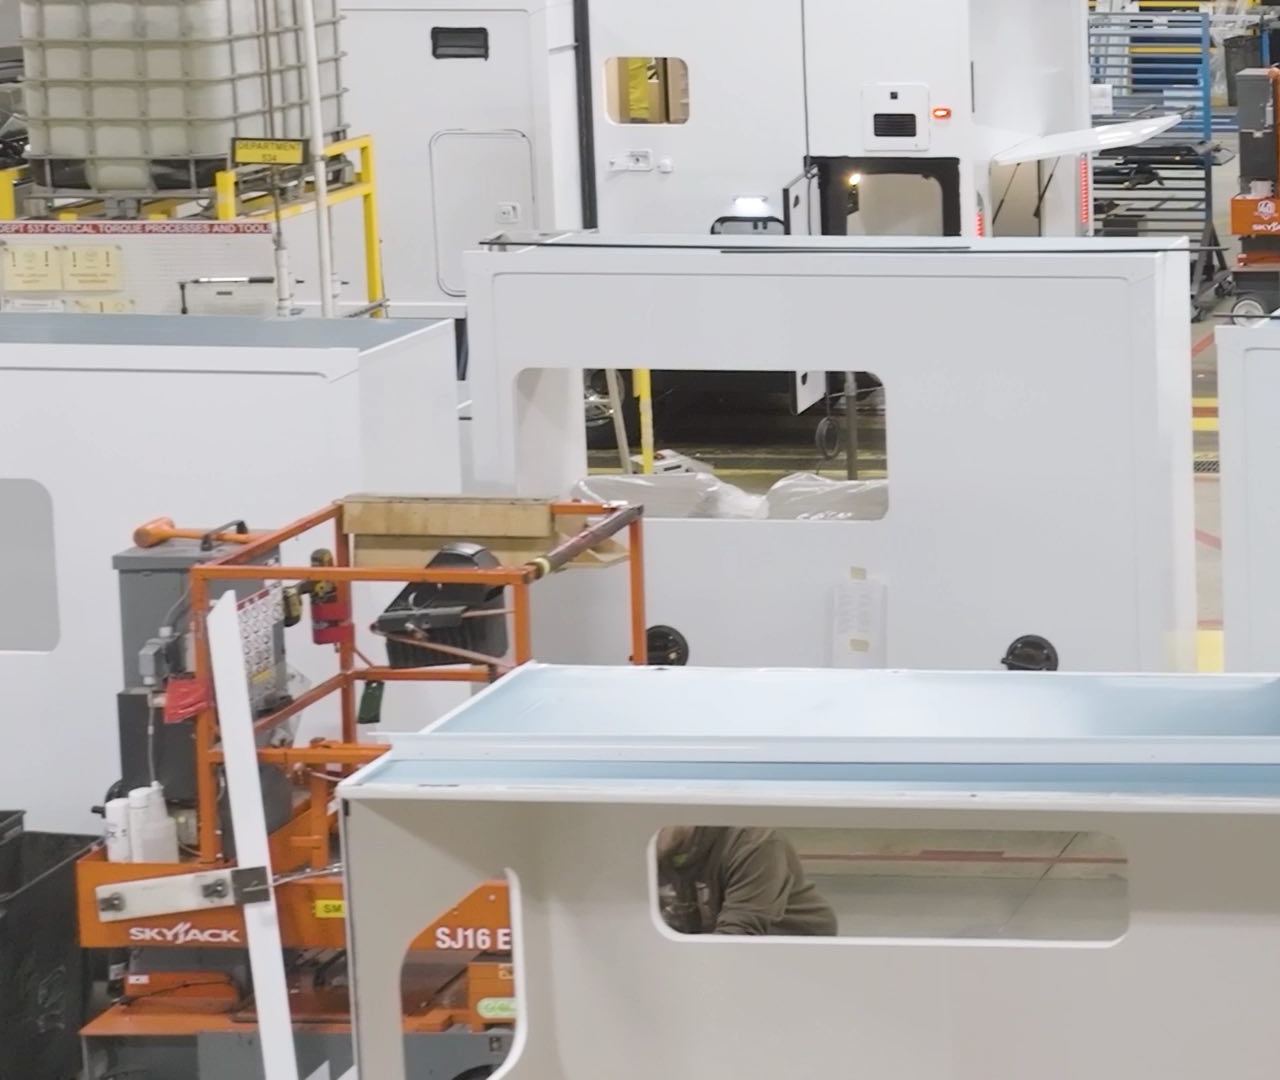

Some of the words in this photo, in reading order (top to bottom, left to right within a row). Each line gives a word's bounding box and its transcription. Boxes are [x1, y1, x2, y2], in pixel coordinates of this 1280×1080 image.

[49, 223, 94, 234] CRITICAL
[99, 223, 142, 234] TORQUE
[144, 223, 210, 234] PROCESSES
[212, 223, 237, 234] AND
[128, 921, 240, 944] SKYJACK
[435, 927, 491, 949] SJ16
[497, 928, 512, 949] E
